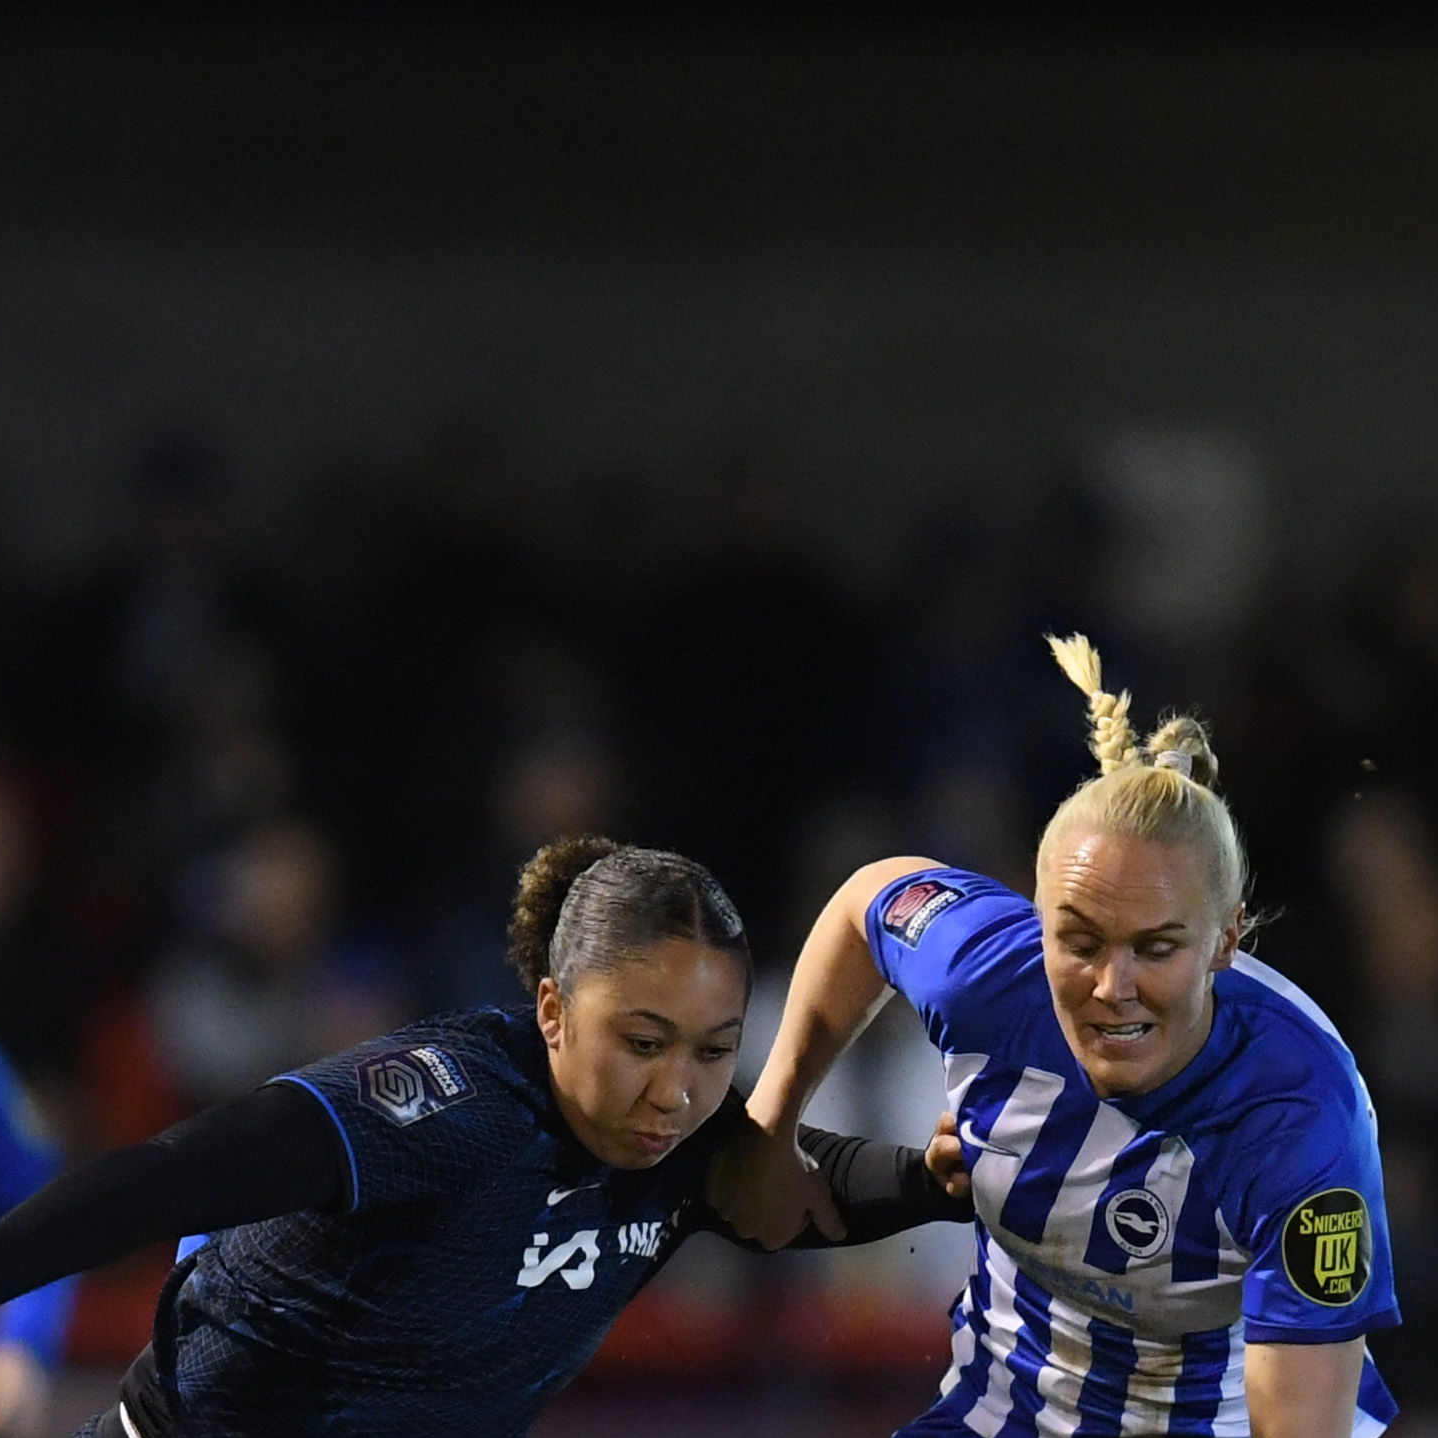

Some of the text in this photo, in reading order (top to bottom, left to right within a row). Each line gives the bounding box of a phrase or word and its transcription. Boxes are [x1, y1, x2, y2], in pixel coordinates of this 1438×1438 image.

[417, 1048, 459, 1095] WOMEN'S
[434, 1051, 466, 1091] BARCLAYS
[1299, 1208, 1364, 1235] SNICKERS
[1321, 1236, 1353, 1272] UK
